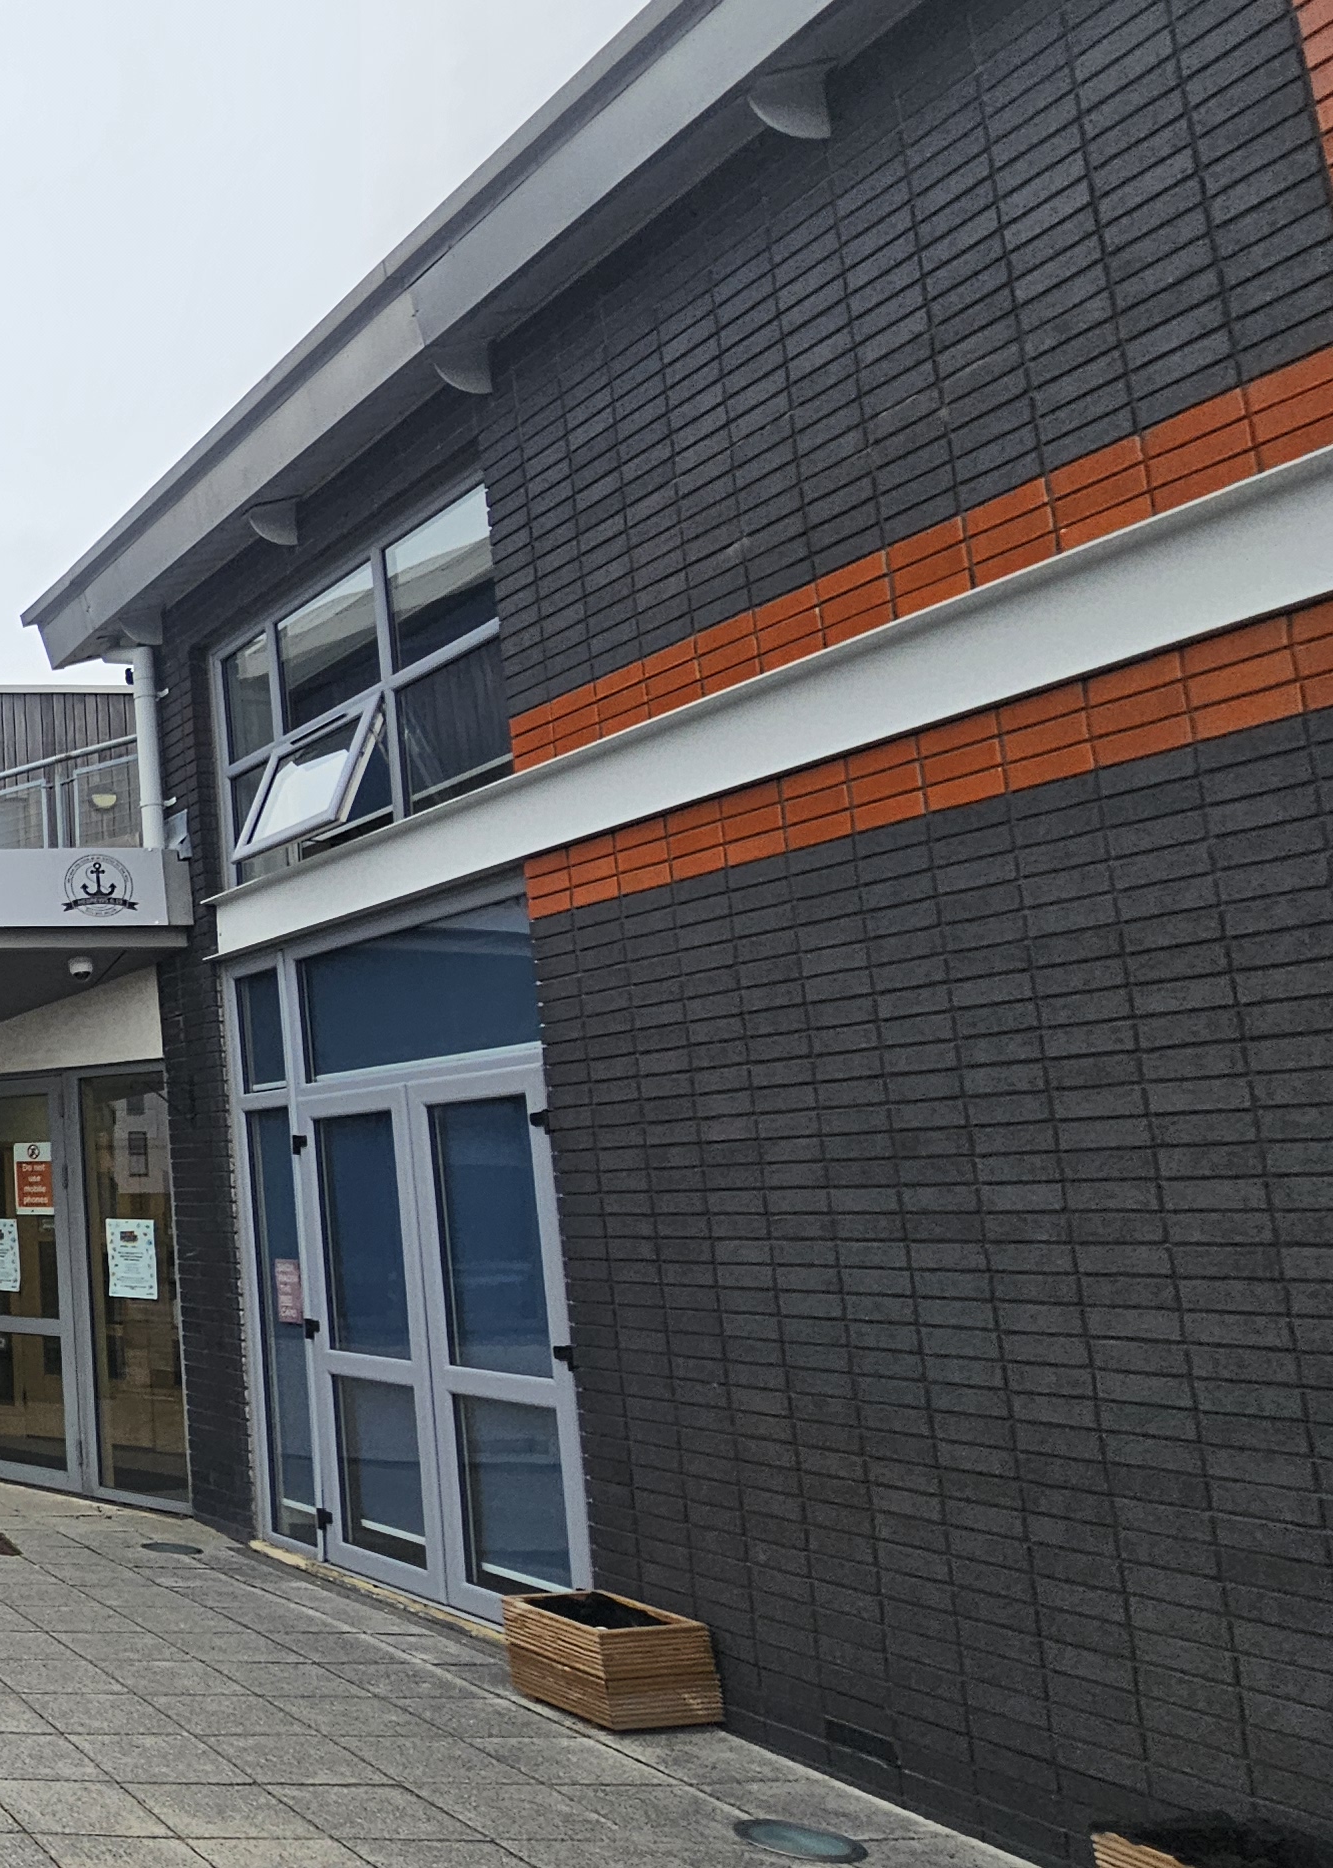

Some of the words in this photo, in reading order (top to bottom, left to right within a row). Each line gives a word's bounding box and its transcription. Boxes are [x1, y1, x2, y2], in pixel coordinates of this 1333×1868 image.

[22, 1163, 33, 1172] Do
[33, 1164, 46, 1172] not
[23, 1185, 47, 1193] mobile
[23, 1196, 49, 1205] phones
